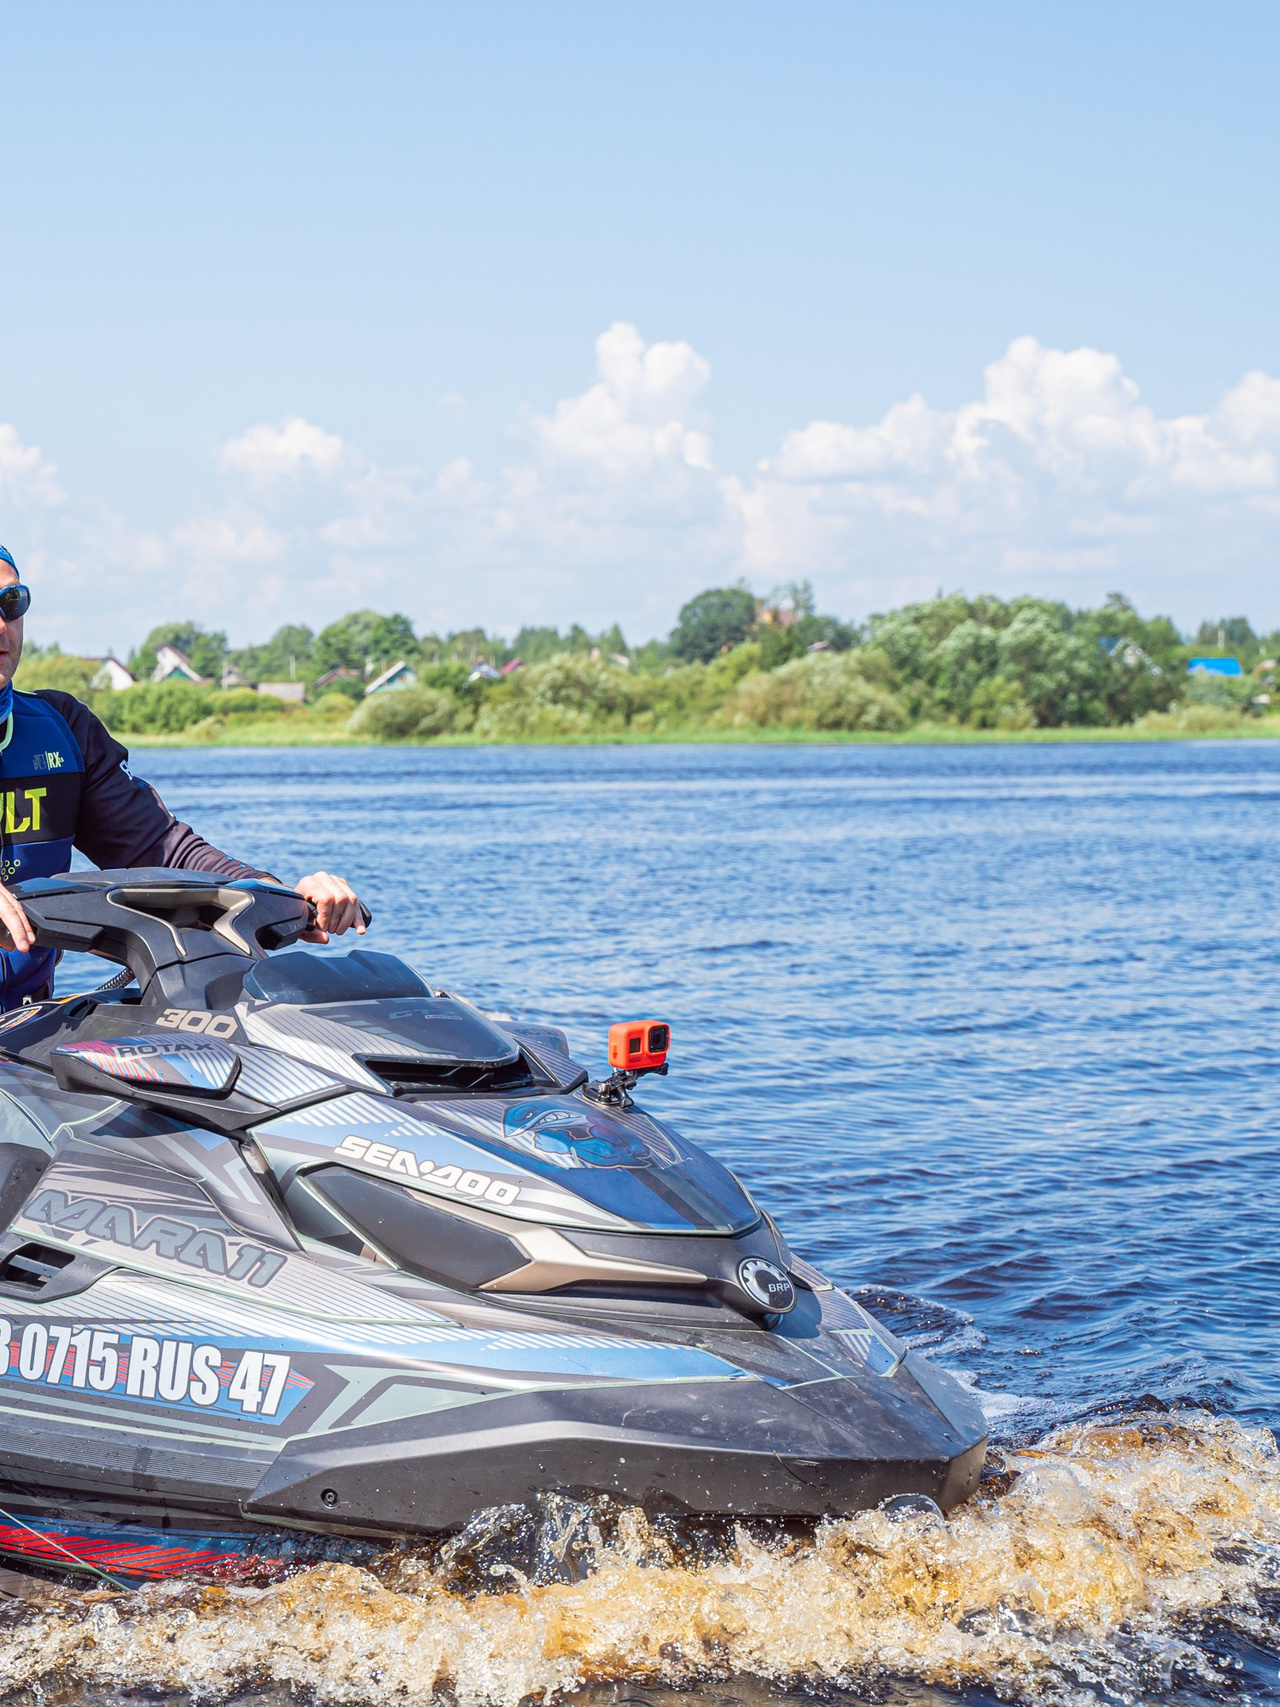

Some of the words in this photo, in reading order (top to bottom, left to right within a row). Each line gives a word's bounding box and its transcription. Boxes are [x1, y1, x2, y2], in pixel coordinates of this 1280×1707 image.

[156, 1008, 239, 1039] 300
[119, 1043, 216, 1058] ROTAX
[768, 1283, 790, 1292] BRP
[19, 1322, 121, 1392] 0715
[126, 1334, 222, 1407] RUS
[228, 1350, 292, 1416] 47
